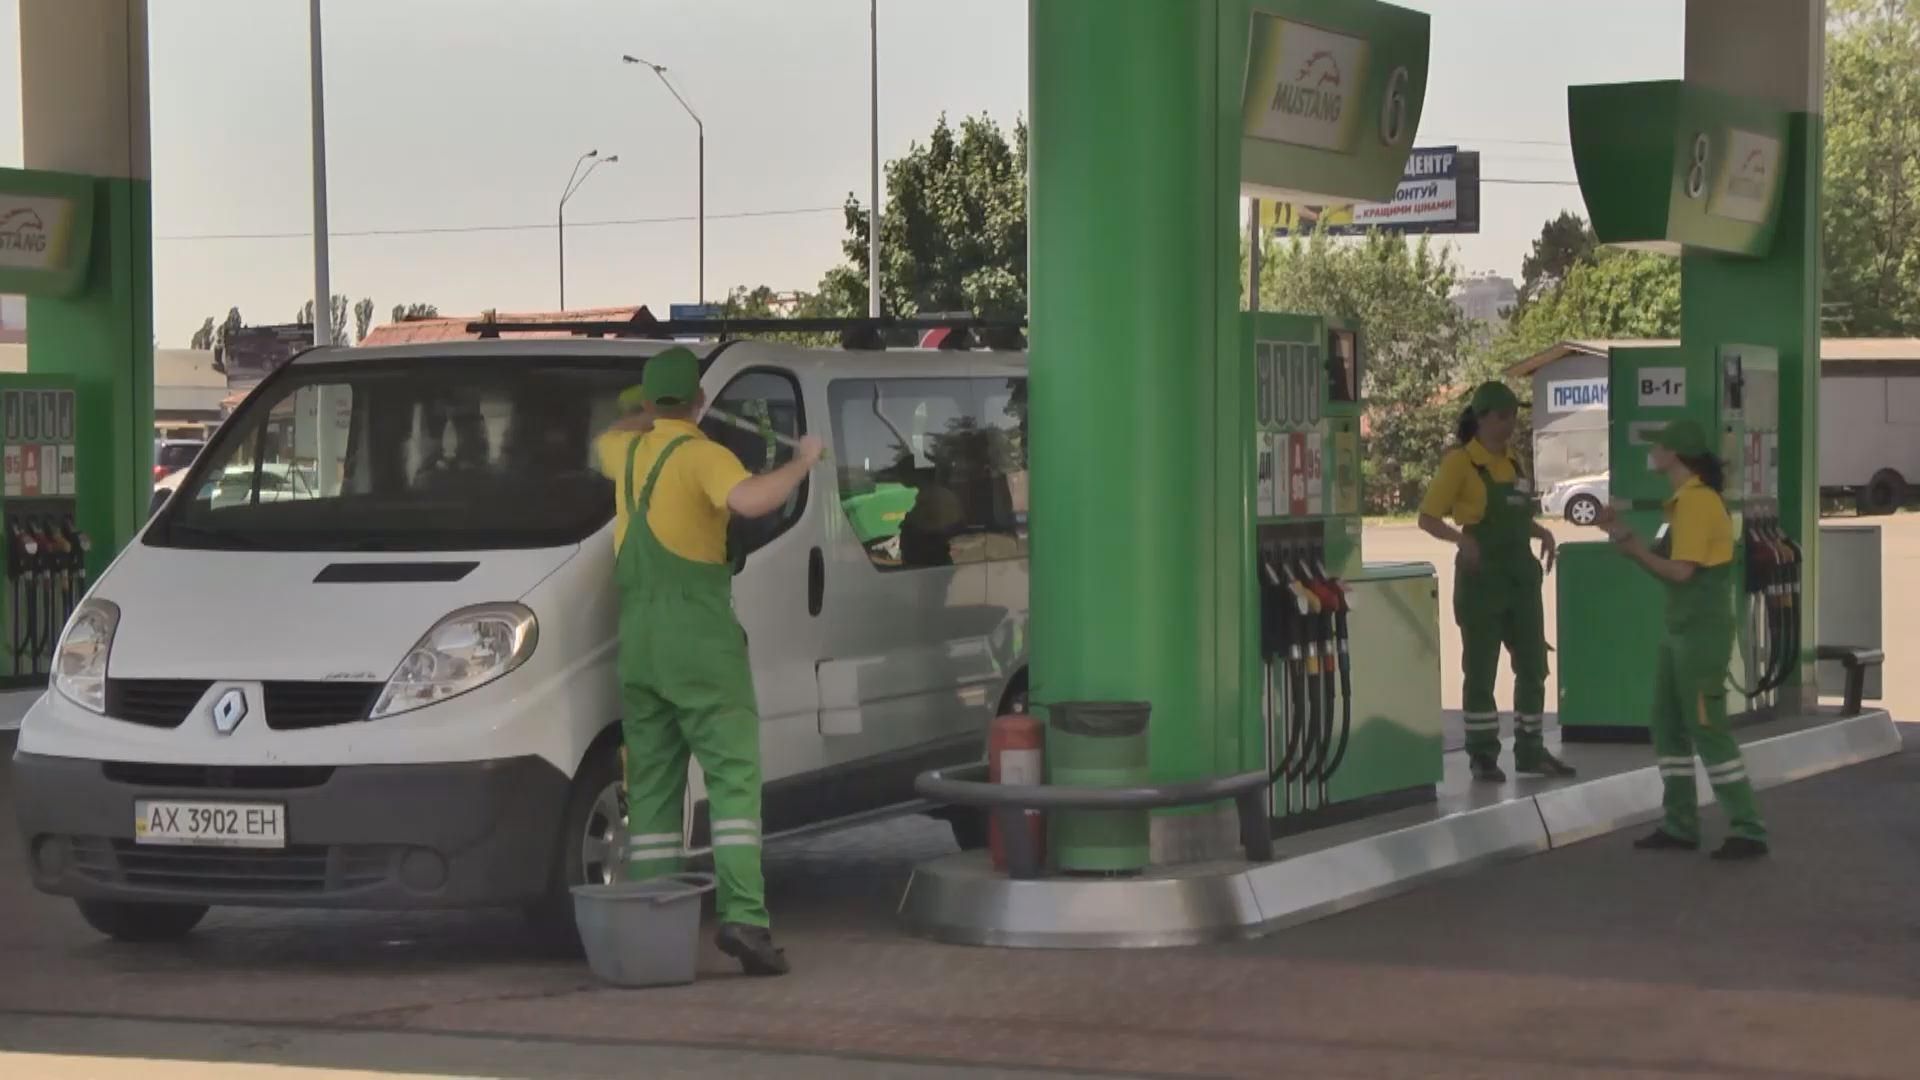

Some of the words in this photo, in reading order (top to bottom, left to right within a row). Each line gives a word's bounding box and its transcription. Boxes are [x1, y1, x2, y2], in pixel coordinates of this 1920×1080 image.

[1271, 82, 1341, 123] MUSTANG
[1382, 65, 1409, 146] 6
[1688, 132, 1709, 198] 8
[1393, 182, 1438, 200] ОНТУЙ
[150, 807, 180, 833] AX
[188, 808, 238, 834] 3902
[246, 809, 277, 835] EH
